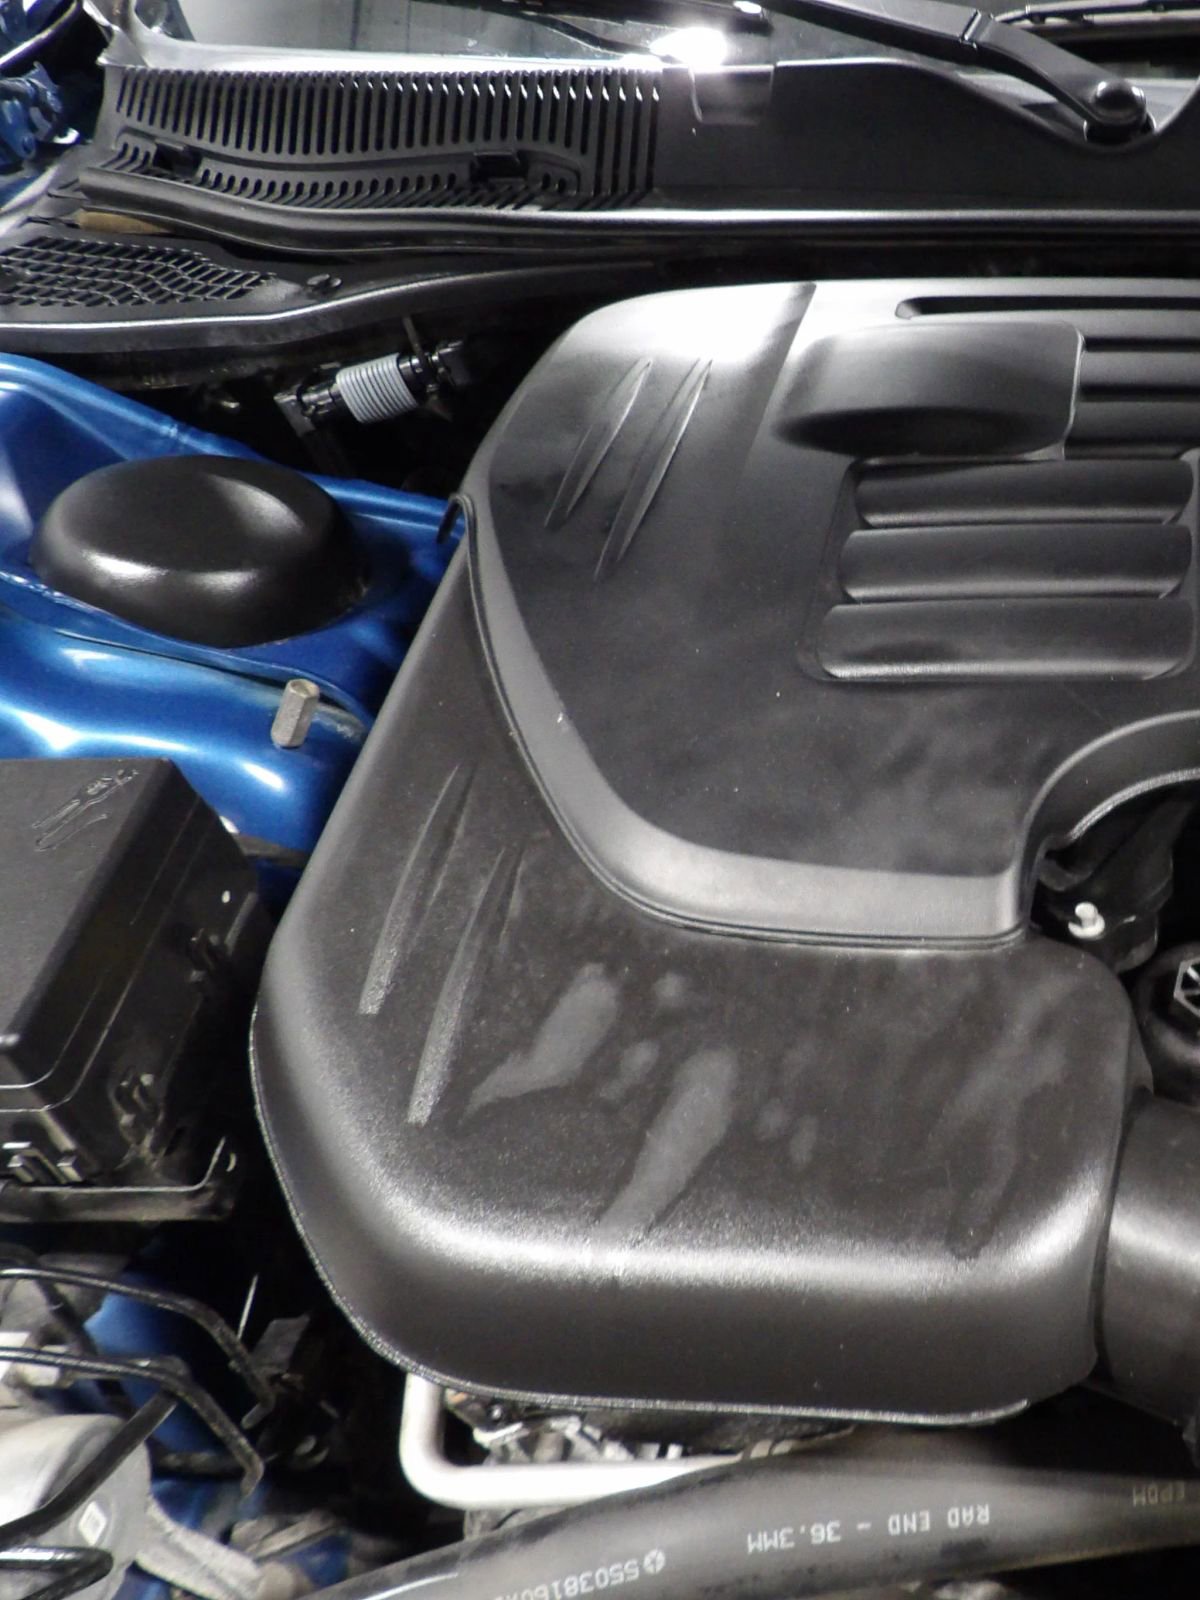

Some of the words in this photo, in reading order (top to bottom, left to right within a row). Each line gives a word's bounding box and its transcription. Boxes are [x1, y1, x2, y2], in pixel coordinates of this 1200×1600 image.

[888, 1510, 931, 1536] END
[947, 1503, 991, 1529] RAD
[747, 1519, 842, 1554] 36.3MM
[493, 1559, 640, 1600] 55038160
